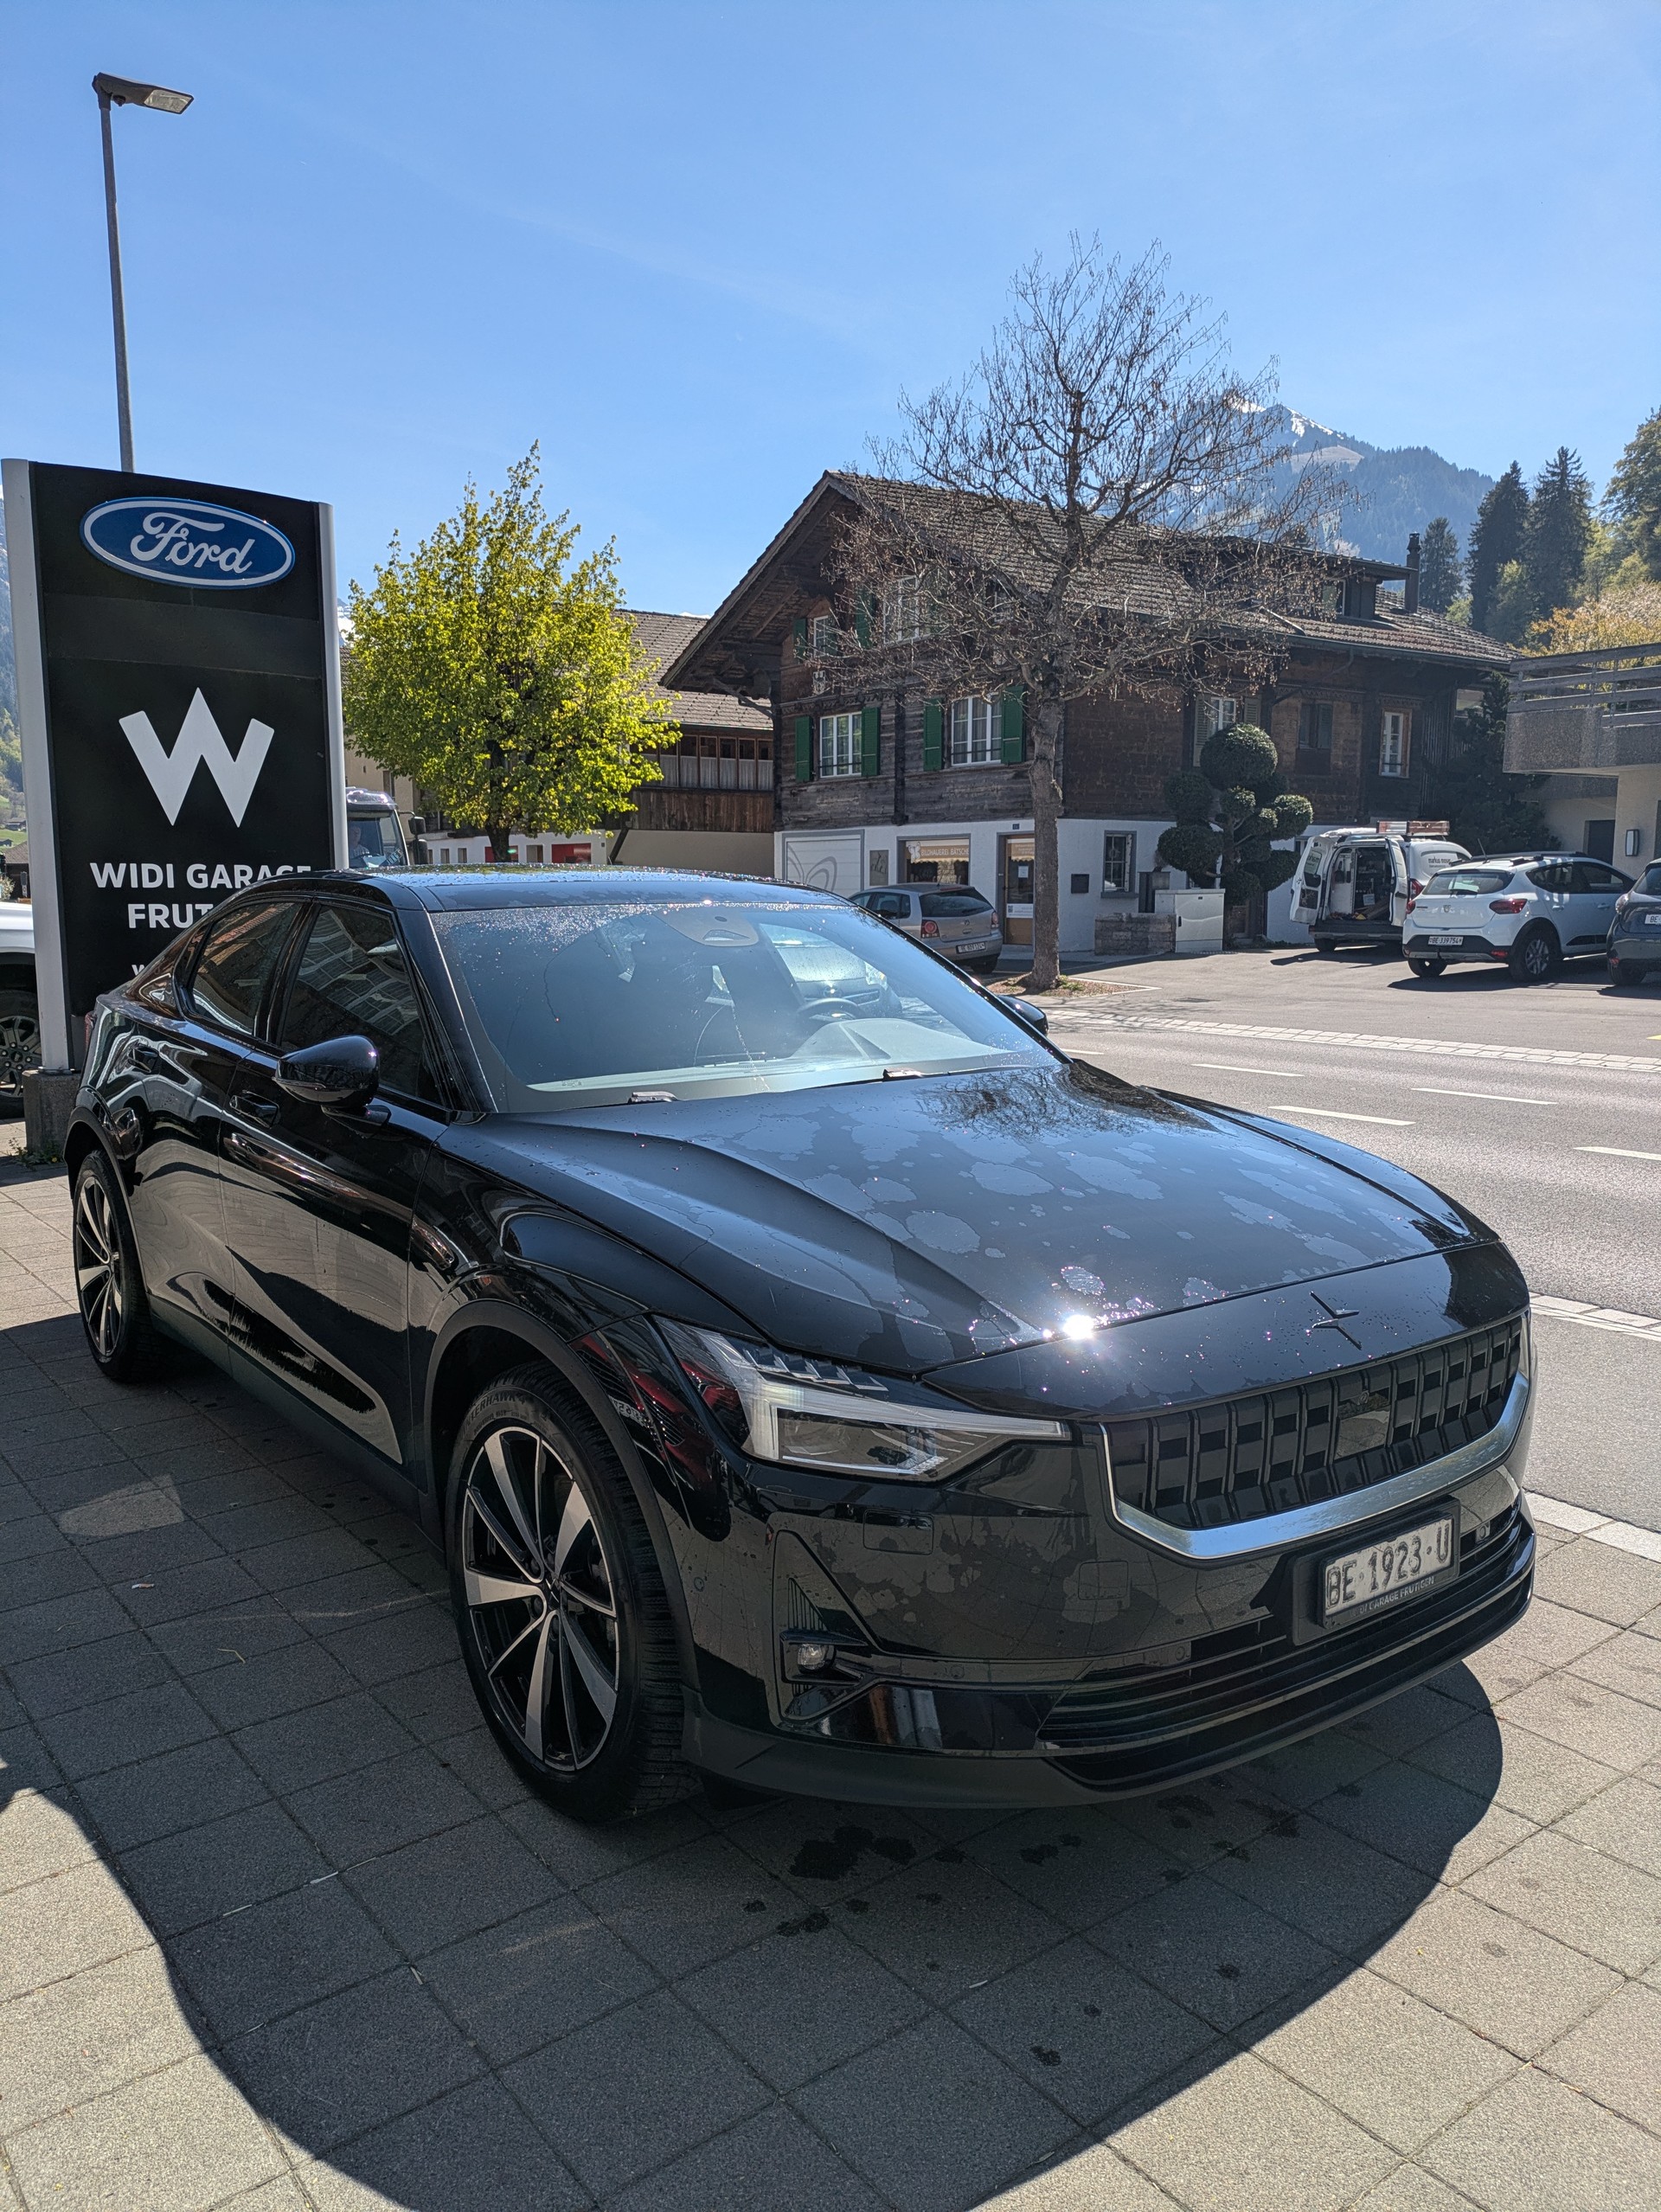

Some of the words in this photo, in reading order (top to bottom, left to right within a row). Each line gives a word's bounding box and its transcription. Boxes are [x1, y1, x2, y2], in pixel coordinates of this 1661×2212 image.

[130, 511, 255, 574] Ford
[119, 687, 275, 828] W
[89, 862, 175, 889] WIDI
[186, 863, 311, 889] GARA
[1369, 1591, 1400, 1611] GARAGE
[1400, 1575, 1435, 1598] FRUTIGEN
